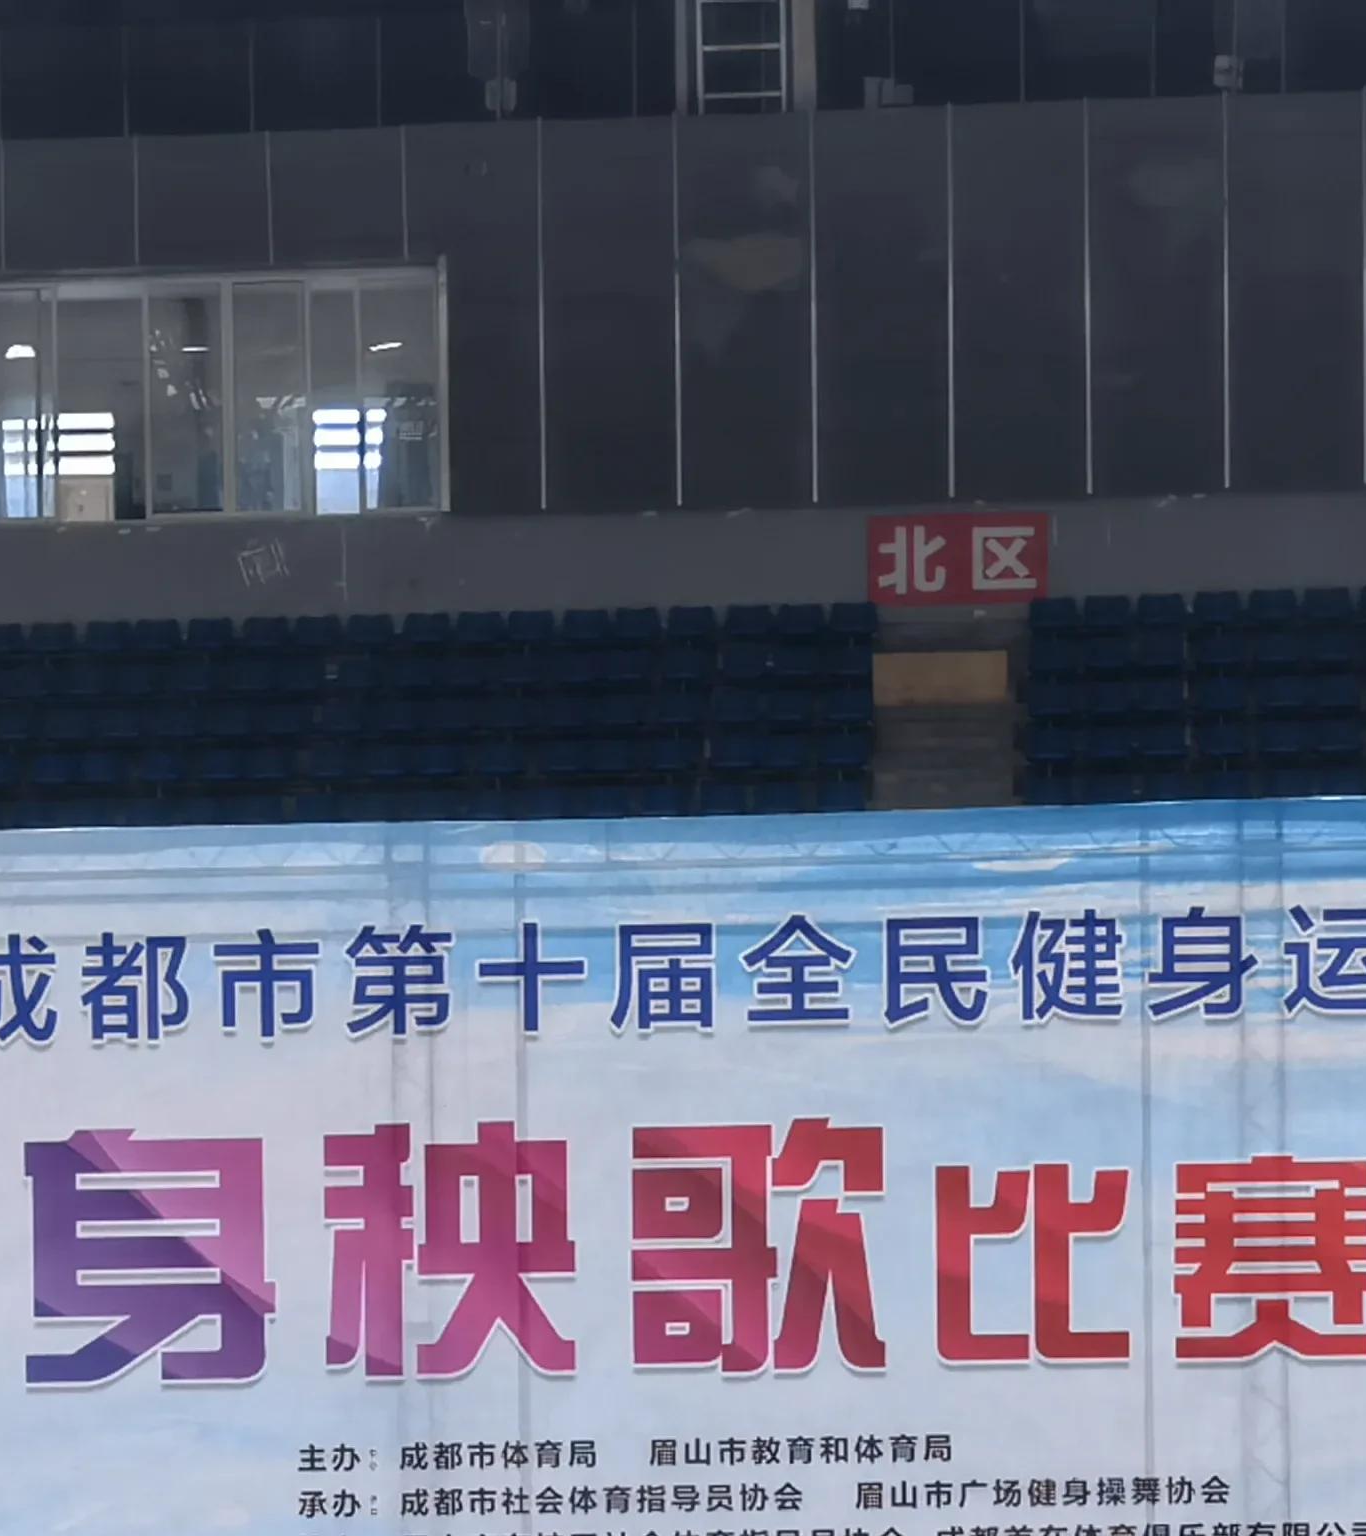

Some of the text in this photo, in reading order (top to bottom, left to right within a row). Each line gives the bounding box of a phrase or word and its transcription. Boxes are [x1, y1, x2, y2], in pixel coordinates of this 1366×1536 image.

[877, 523, 1038, 595] 北区
[648, 1434, 953, 1467] 眉山市教育和体育局
[854, 1474, 1232, 1511] 眉山市广场健身操舞协会
